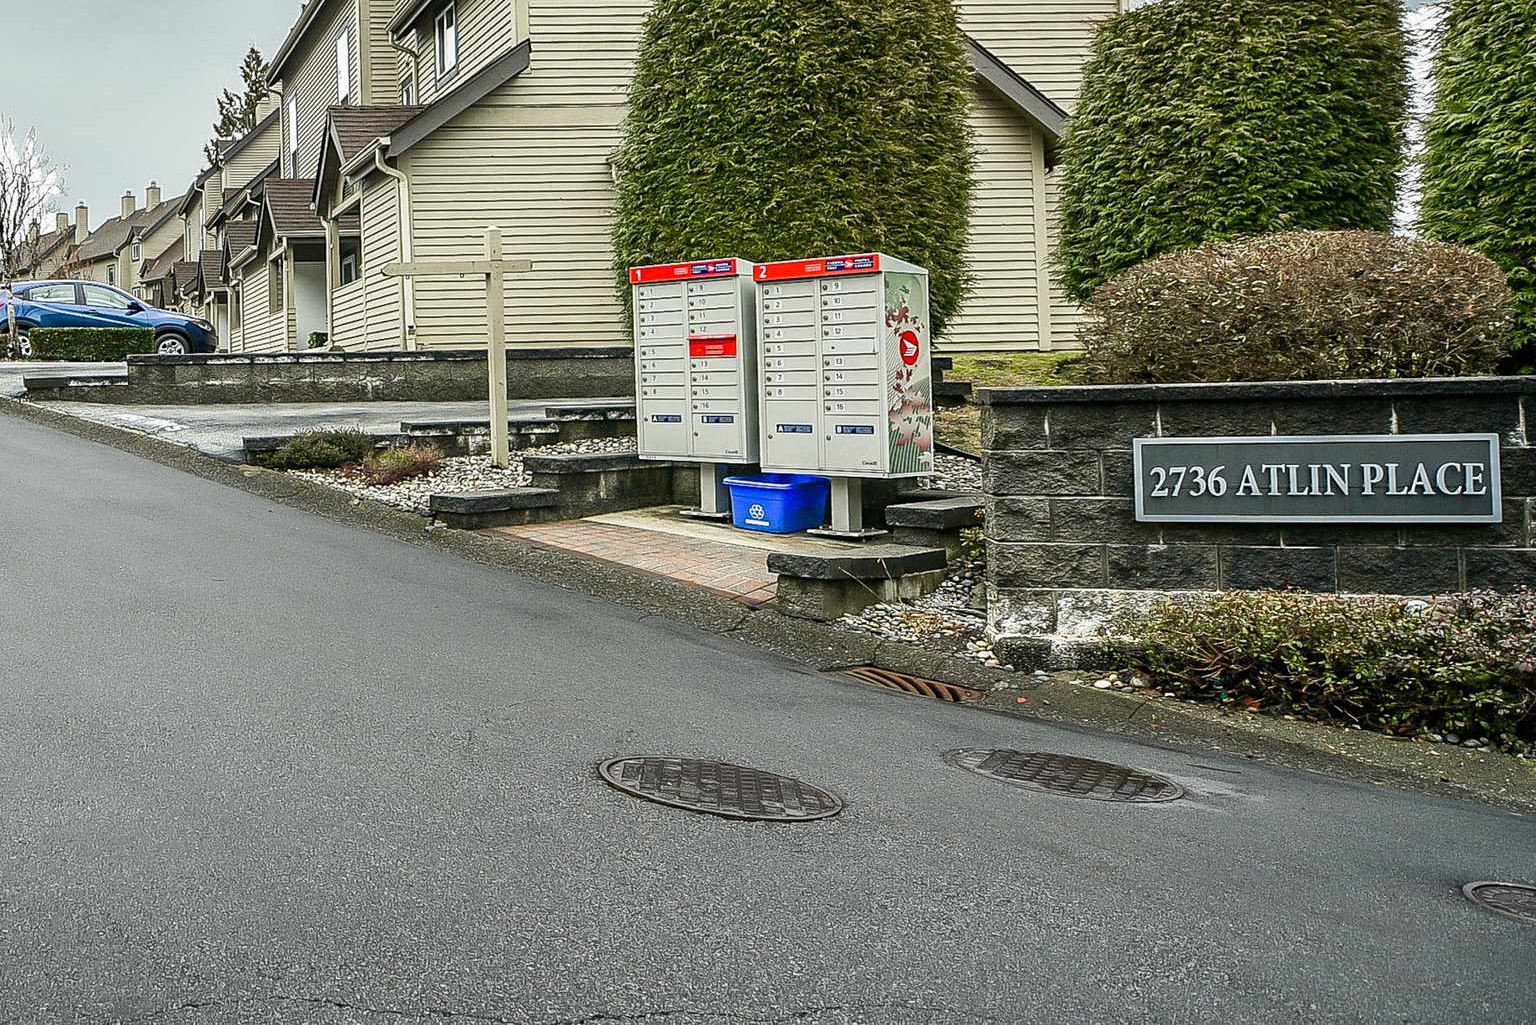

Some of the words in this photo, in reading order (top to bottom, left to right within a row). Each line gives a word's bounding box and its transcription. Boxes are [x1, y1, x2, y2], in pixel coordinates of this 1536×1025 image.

[635, 269, 641, 281] 1
[759, 266, 767, 279] 2
[1149, 465, 1227, 498] 2736
[1235, 463, 1351, 497] ATLIN
[1360, 461, 1487, 496] PLACE
